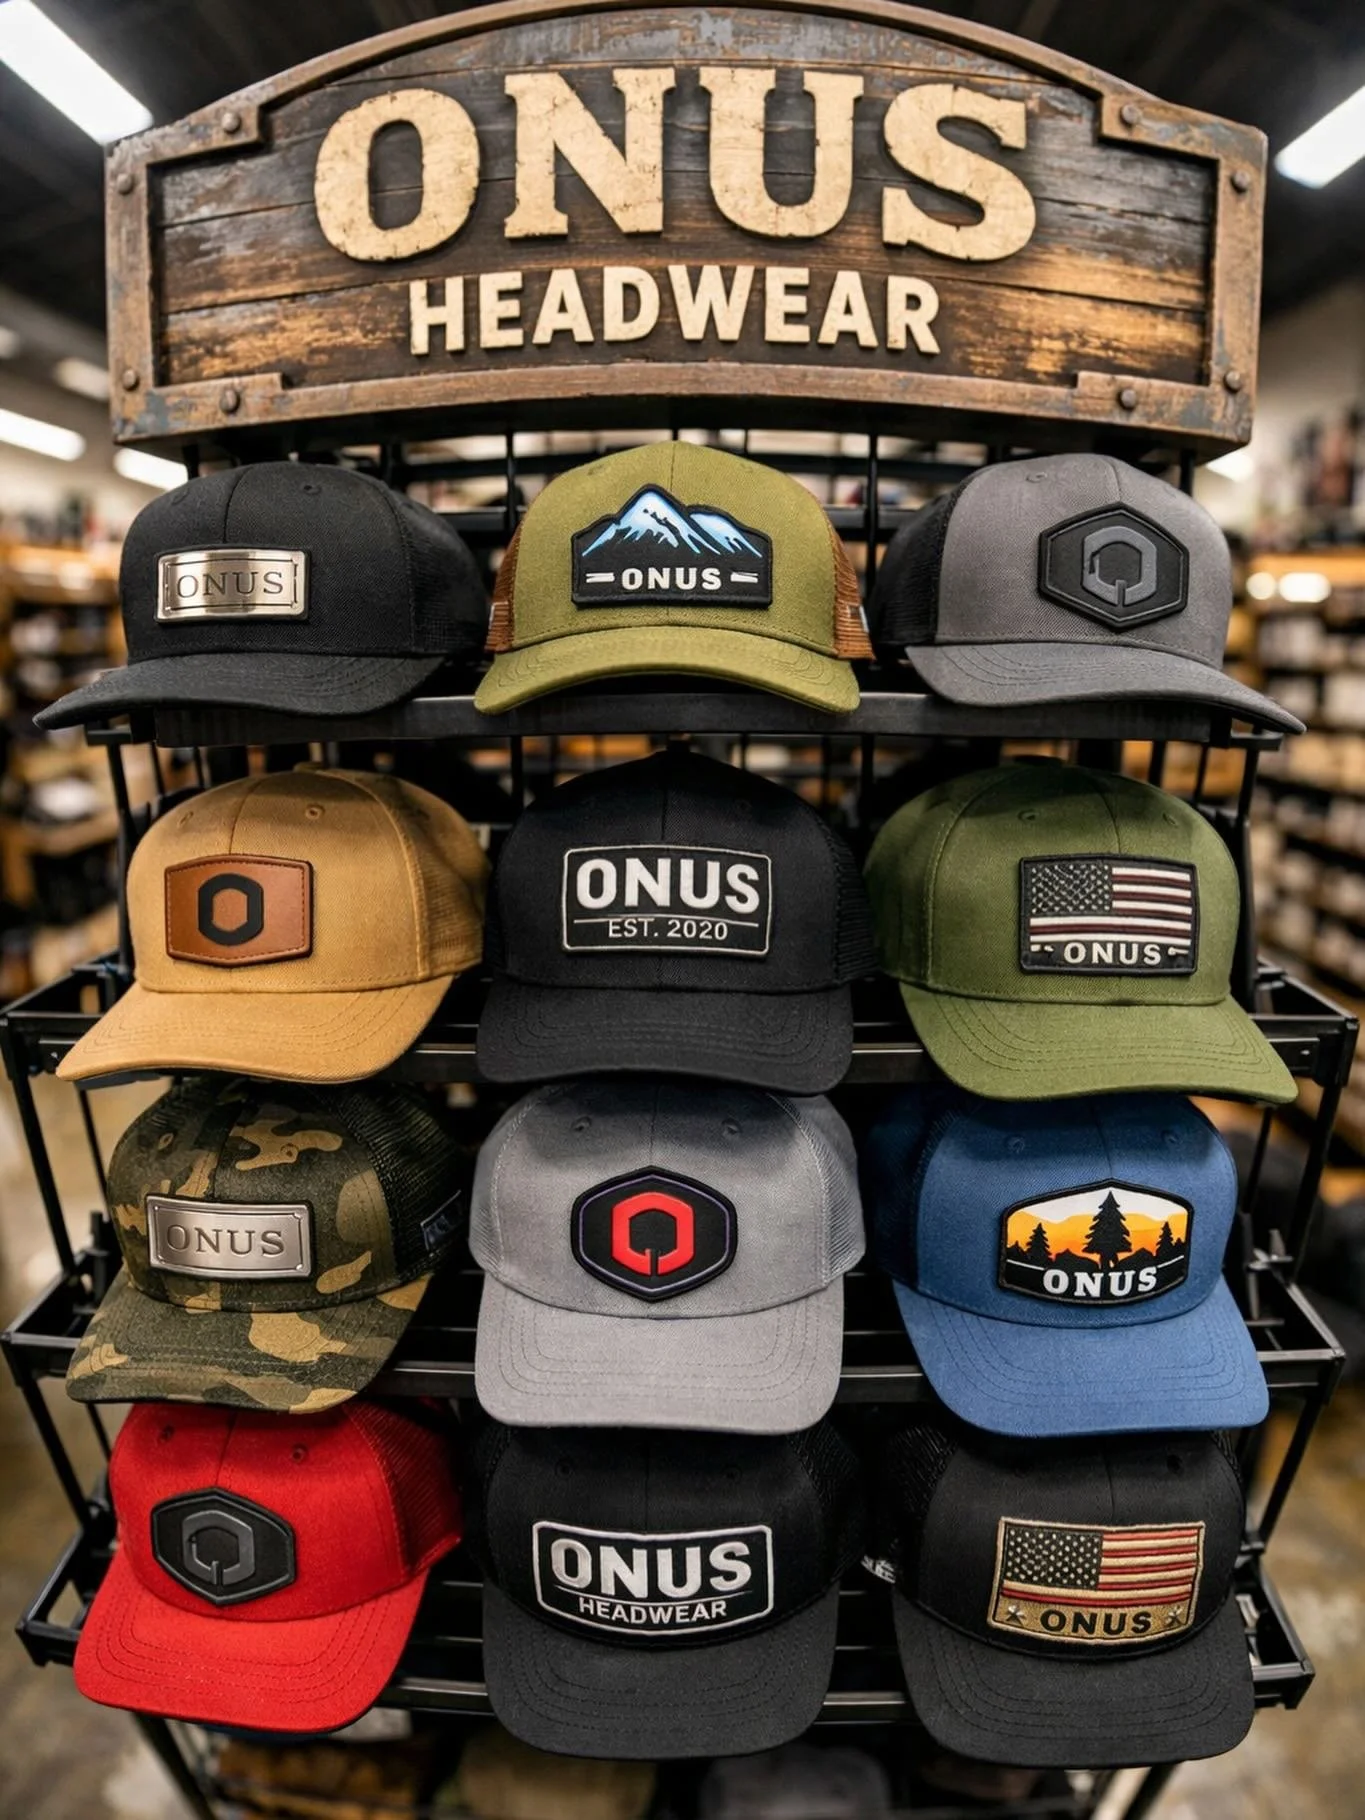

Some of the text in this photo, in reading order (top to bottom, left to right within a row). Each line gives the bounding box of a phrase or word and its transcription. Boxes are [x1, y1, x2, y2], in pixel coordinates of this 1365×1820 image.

[314, 67, 1037, 262] ONUS
[410, 264, 940, 356] HEADWEAR
[176, 570, 285, 599] ONUS
[621, 566, 722, 590] ONUS
[576, 857, 761, 913] ONUS
[608, 918, 728, 940] EST. 2020
[1063, 941, 1162, 966] ONUS
[166, 1224, 285, 1256] ONUS
[1043, 1265, 1159, 1298] ONUS
[550, 1537, 753, 1600] ONUS
[578, 1597, 727, 1625] HEADWEAR
[1039, 1608, 1153, 1635] ONUS
